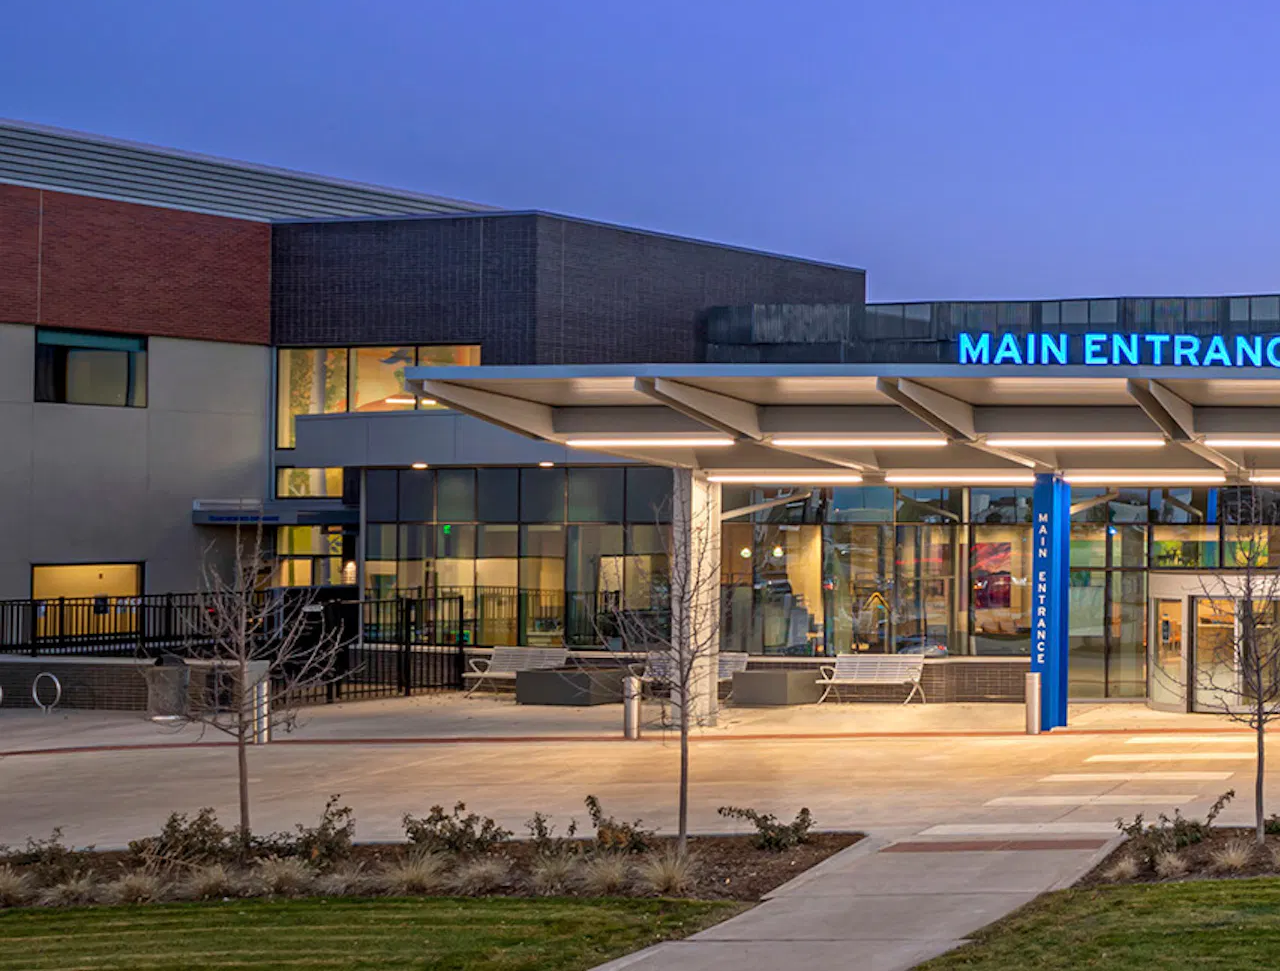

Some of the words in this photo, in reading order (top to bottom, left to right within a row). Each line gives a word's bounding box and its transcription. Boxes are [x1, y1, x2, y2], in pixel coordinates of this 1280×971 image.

[958, 332, 1068, 365] MAIN
[1037, 513, 1049, 558] MAIN
[1036, 571, 1048, 664] ENTRANCE
